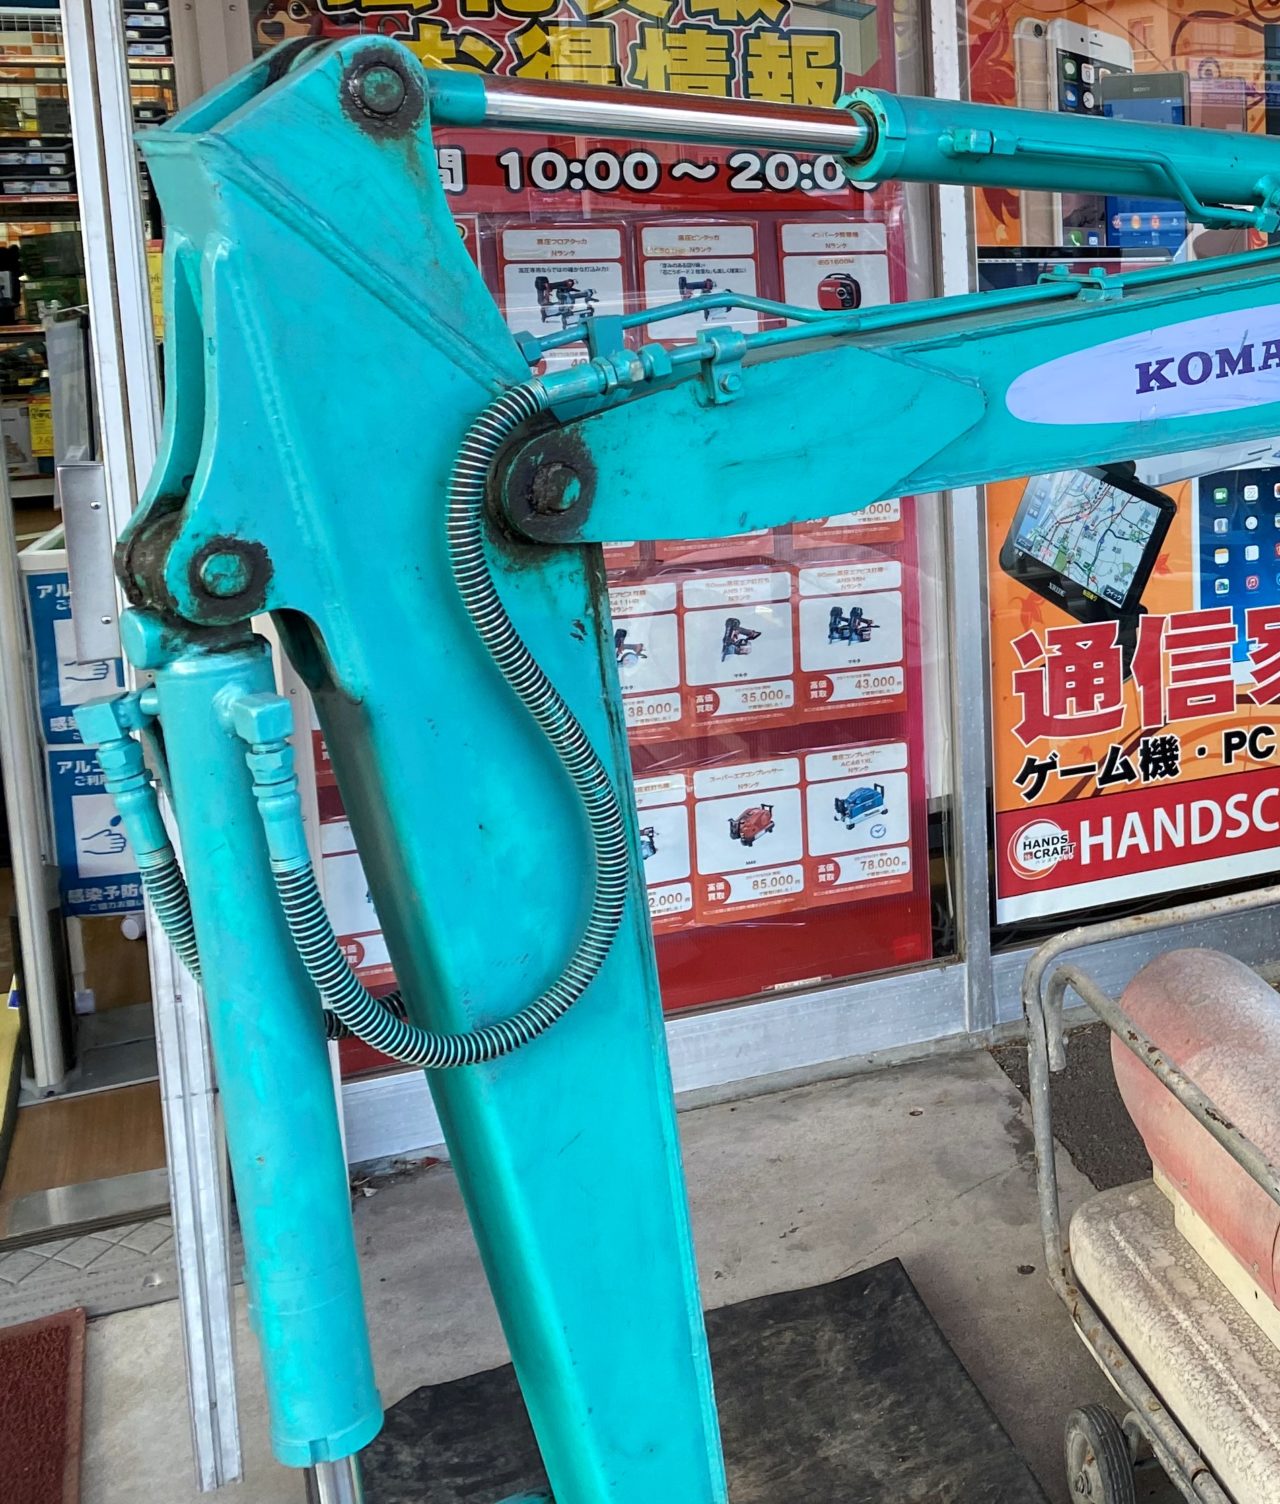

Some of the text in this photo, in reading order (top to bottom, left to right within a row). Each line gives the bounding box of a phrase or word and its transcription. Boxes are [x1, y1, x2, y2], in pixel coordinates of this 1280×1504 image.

[500, 150, 660, 191] 10:00
[729, 152, 880, 191] 20:0
[1014, 734, 1181, 802] ゲーム機
[1222, 724, 1277, 766] PC
[1023, 834, 1069, 851] HANDS
[1033, 844, 1075, 860] CRAFT
[68, 884, 144, 904] 感染予防
